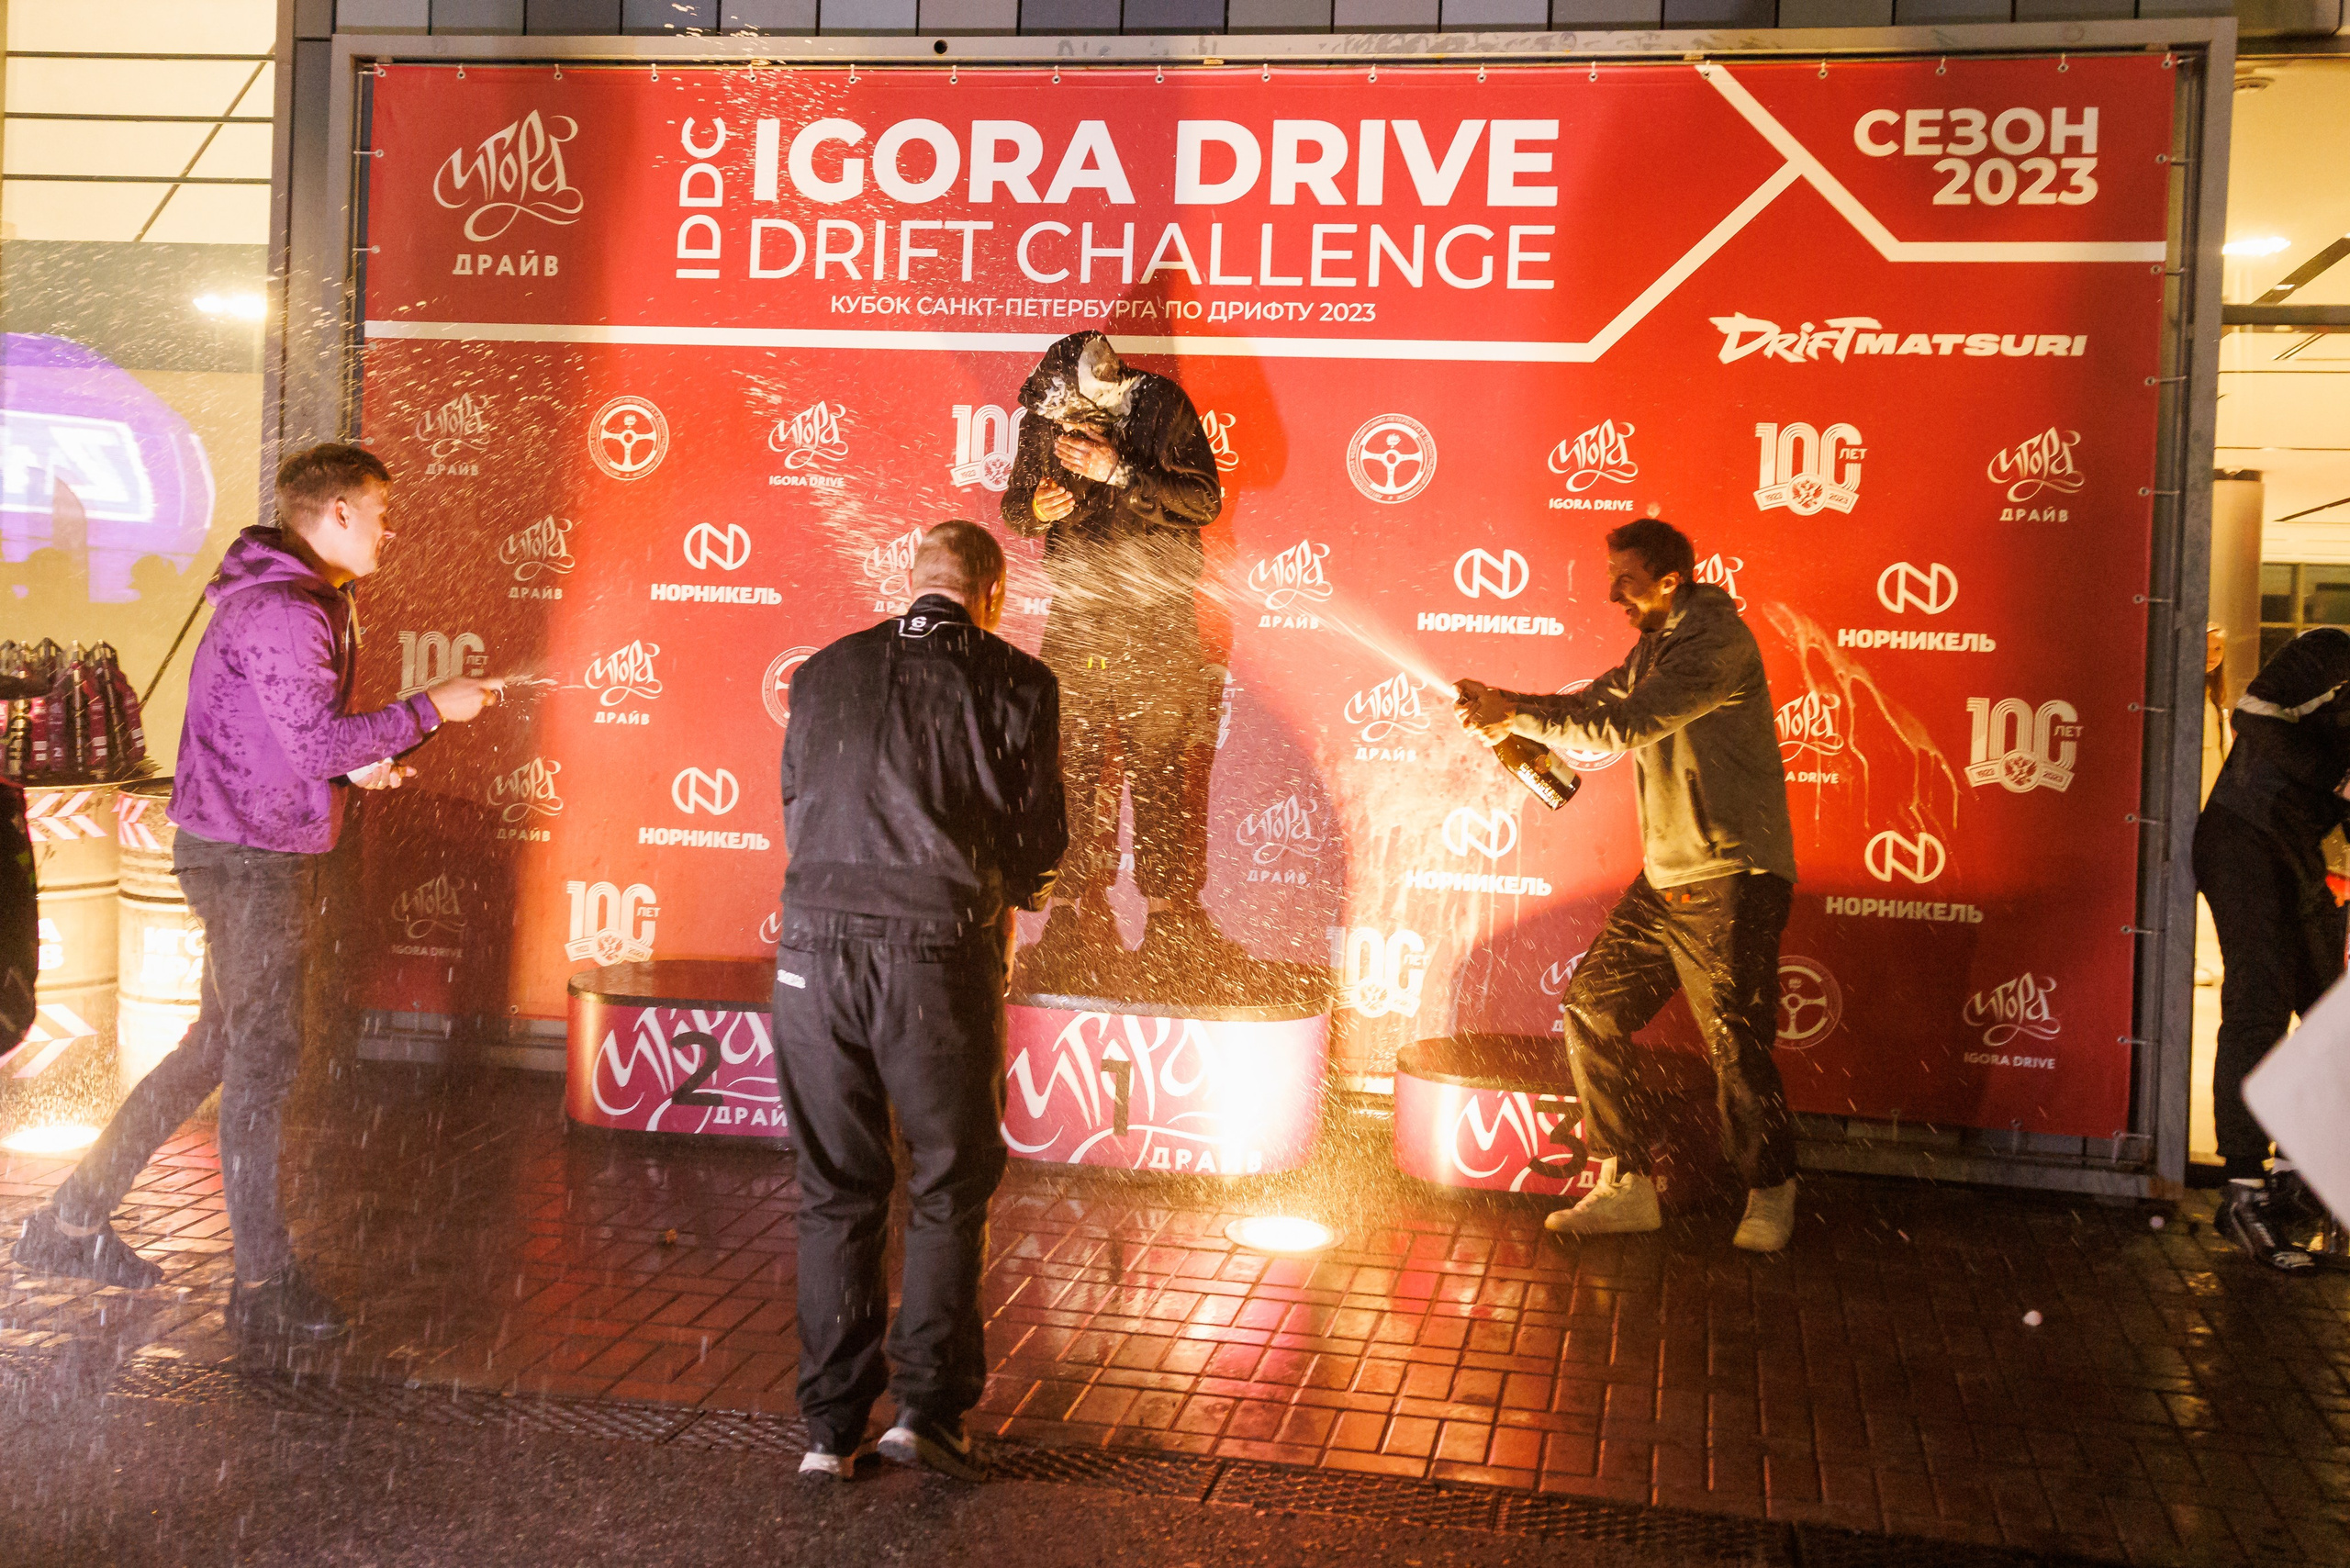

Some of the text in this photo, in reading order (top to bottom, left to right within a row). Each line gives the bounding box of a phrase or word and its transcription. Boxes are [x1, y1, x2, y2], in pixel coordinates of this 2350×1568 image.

[1853, 106, 2099, 157] СЕЗОН
[753, 118, 1560, 207] IGORA DRIVE
[1932, 157, 2099, 206] 2023
[676, 116, 725, 279] IDDC
[452, 248, 559, 277] ДРАЙВ
[749, 218, 1556, 290] DRIFT CHALLENGE
[831, 295, 1377, 323] КУБОК САНКТ-ПЕТЕРБУРГА ПО ДРИФТУ 2023
[1839, 447, 1868, 461] ЛЕТ
[768, 475, 845, 487] IGORA DRIVE
[1549, 498, 1634, 512] IGORA DRIVE
[1999, 506, 2070, 523] ДРАЙВ
[508, 585, 563, 600] ДРАЙВ
[650, 583, 783, 605] НОРНИКЕЛЬ
[1258, 613, 1320, 630] ДРАЙВ
[1416, 611, 1565, 636] НОРНИКЕЛЬ
[1837, 629, 1997, 653] НОРНИКЕЛЬ
[593, 710, 651, 725] ДРАЙВ
[2053, 724, 2085, 738] ЛЕТ
[1354, 745, 1418, 763] ДРАЙВ
[1797, 771, 1840, 785] DRIVE
[497, 827, 551, 843] ДРАЙВ
[638, 827, 770, 850] НОРНИКЕЛЬ
[1405, 869, 1553, 897] НОРНИКЕЛЬ
[636, 906, 661, 918] ЛЕТ
[1826, 895, 1985, 924] НОРНИКЕЛЬ
[670, 1031, 723, 1106] 2
[1964, 1052, 2056, 1070] IGORA DRIVE
[1102, 1059, 1132, 1137] 1
[712, 1104, 789, 1127] ДРАЙ
[1528, 1100, 1588, 1179] 3
